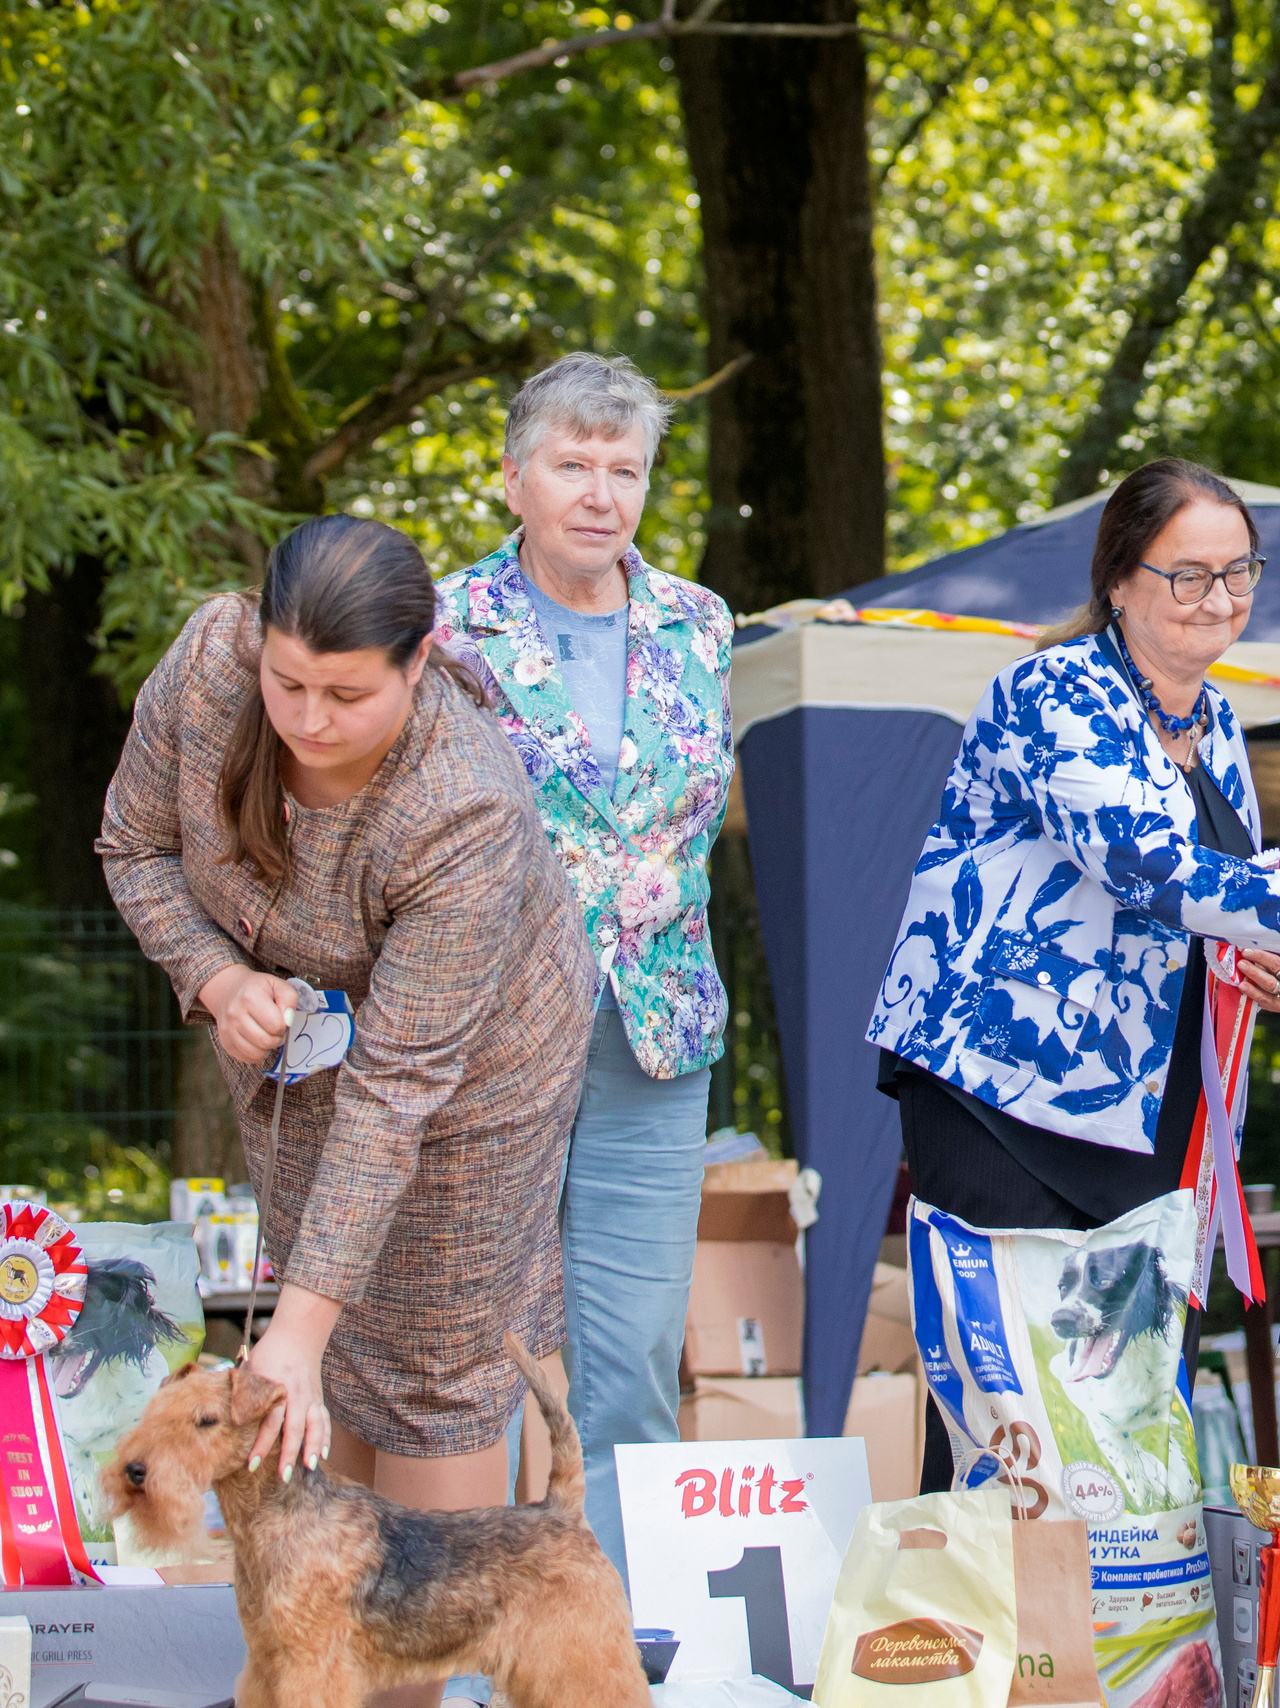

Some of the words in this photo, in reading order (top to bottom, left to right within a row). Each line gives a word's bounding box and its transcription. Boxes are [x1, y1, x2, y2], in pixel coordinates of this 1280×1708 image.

[286, 1012, 345, 1069] 52
[6, 1451, 33, 1464] BEST
[17, 1469, 30, 1480] IN
[10, 1486, 43, 1498] SHOW
[674, 1463, 810, 1520] Blitz
[1075, 1482, 1113, 1500] 44%
[1087, 1526, 1159, 1544] ИНДЕЙКА
[1101, 1546, 1141, 1559] УТКА
[1101, 1571, 1142, 1582] Комплекс
[707, 1545, 815, 1701] 1
[42, 1650, 64, 1662] GRILL
[67, 1649, 93, 1661] PRESS
[870, 1649, 960, 1669] лакомства
